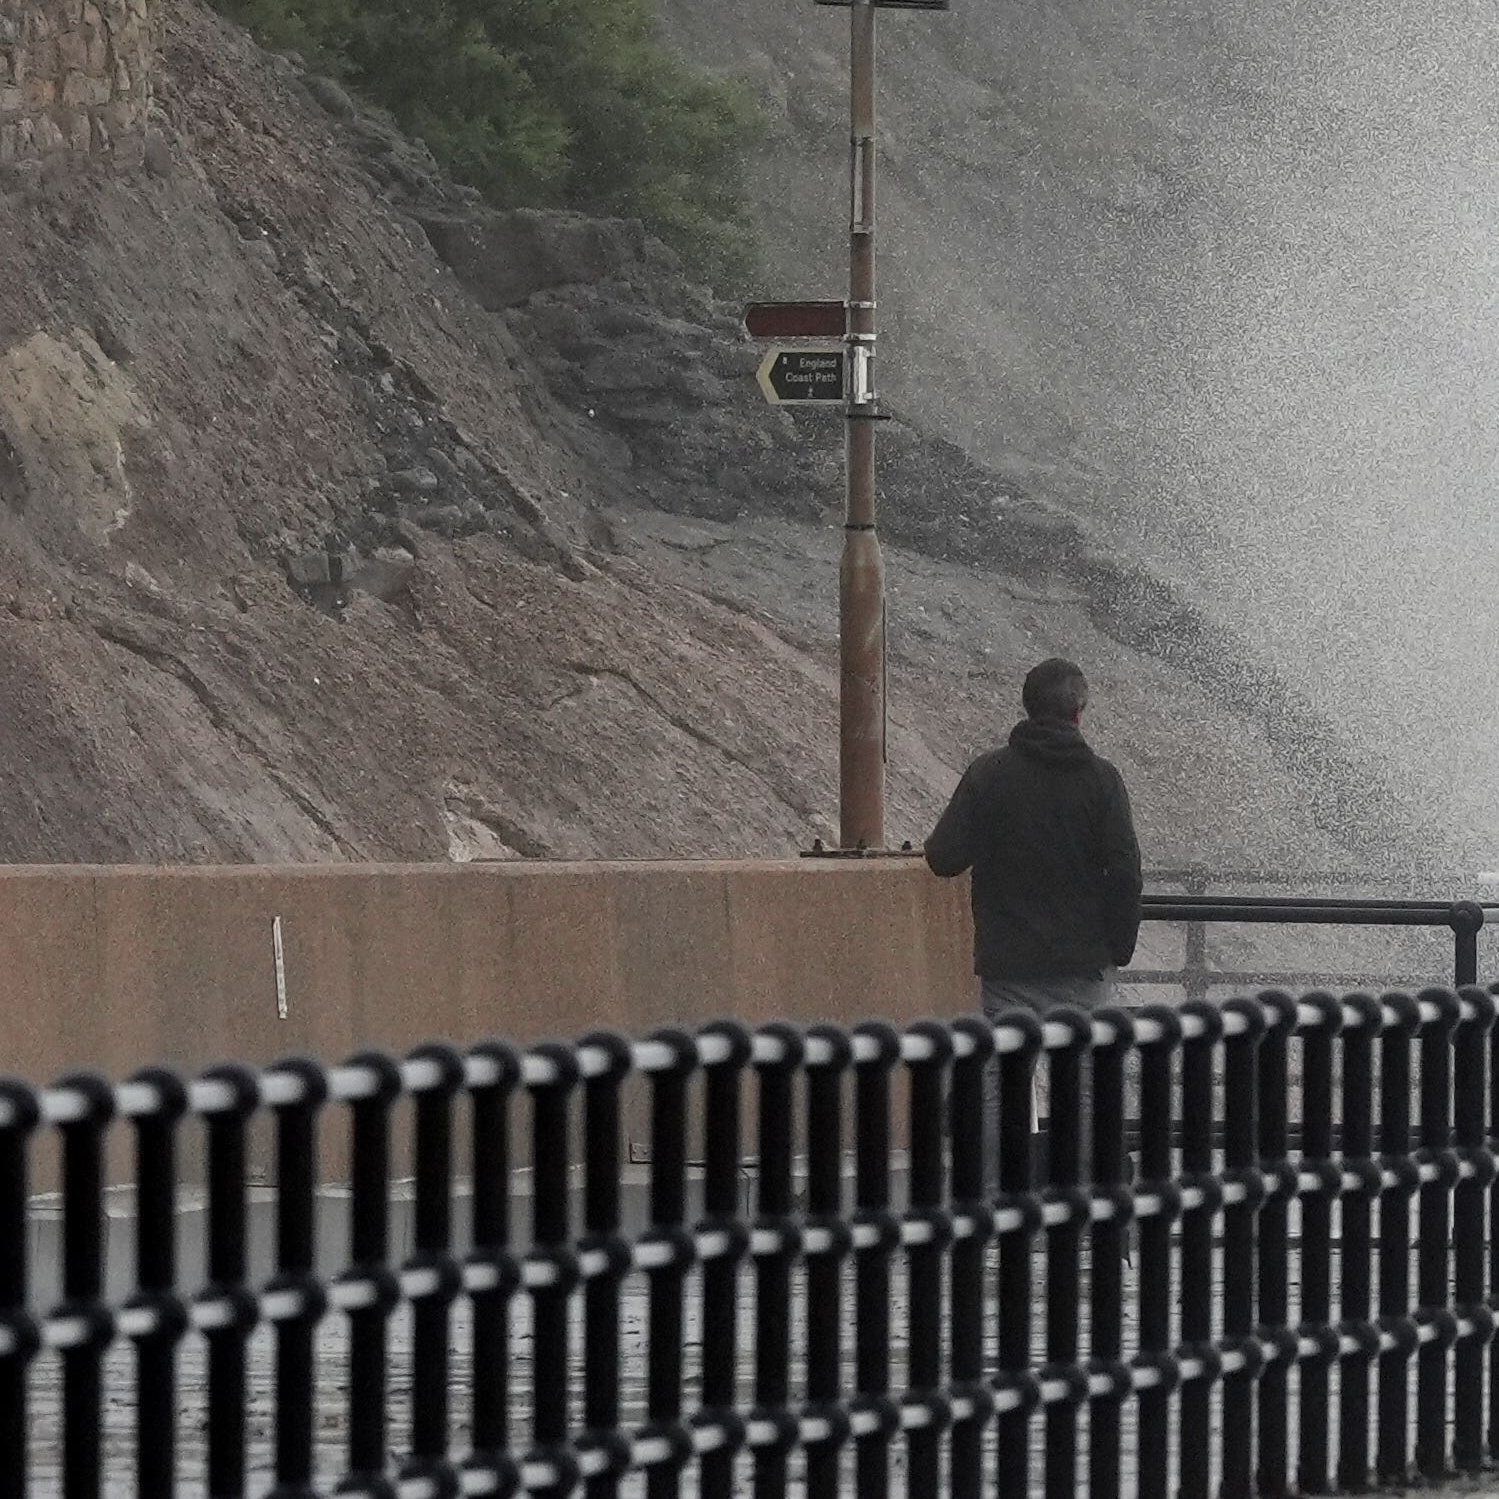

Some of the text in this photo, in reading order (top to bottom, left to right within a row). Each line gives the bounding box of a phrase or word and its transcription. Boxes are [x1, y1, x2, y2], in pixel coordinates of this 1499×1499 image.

[799, 357, 837, 370] England
[785, 372, 837, 383] Coast Path
